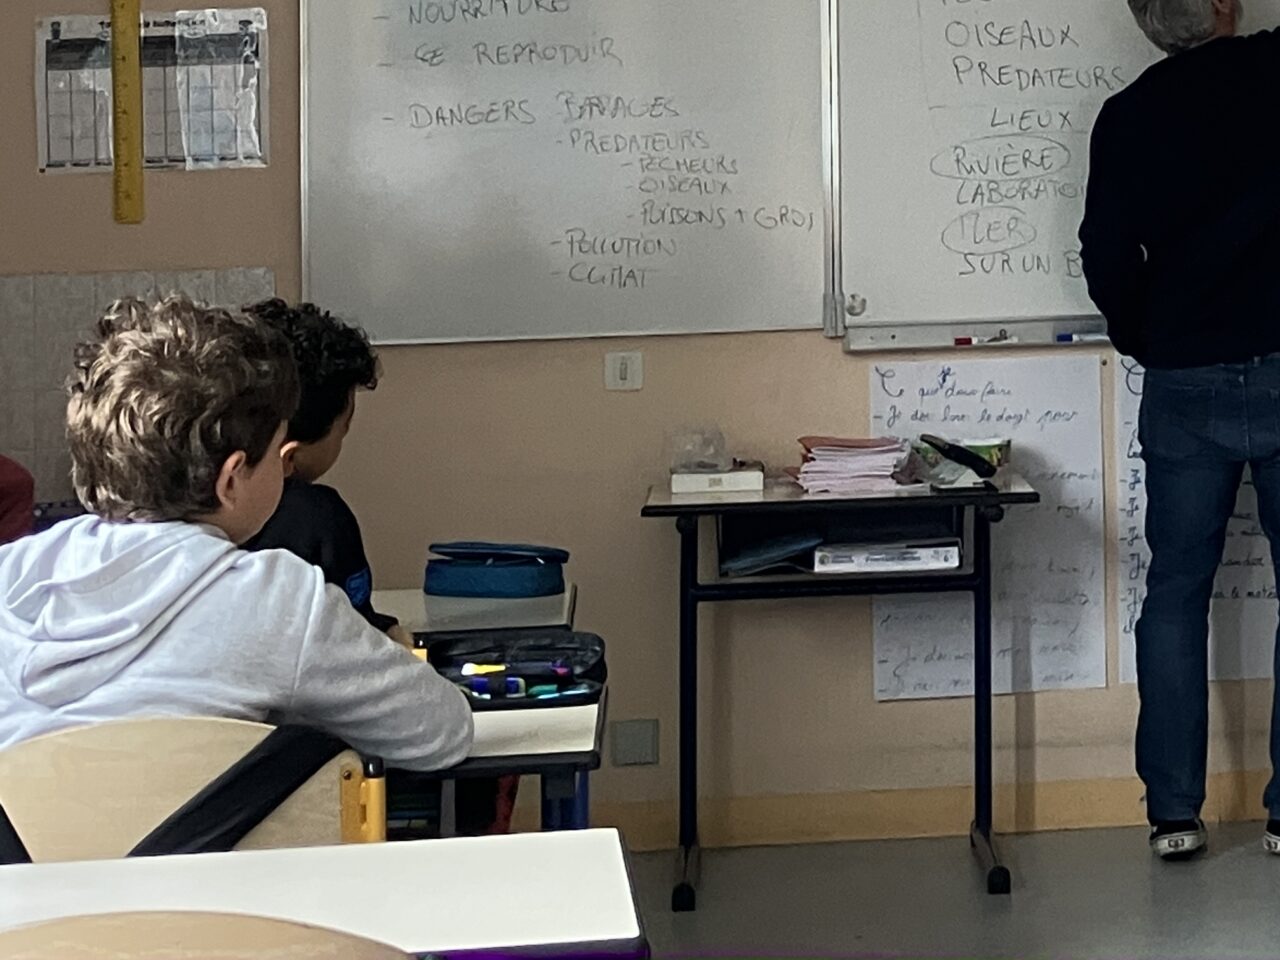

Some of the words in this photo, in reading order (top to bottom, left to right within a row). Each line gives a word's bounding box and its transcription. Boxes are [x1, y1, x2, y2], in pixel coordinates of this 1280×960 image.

[944, 18, 1080, 51] OISEAUX
[951, 54, 1131, 92] PREDATEURS
[408, 98, 538, 129] DANGERS
[989, 106, 1073, 132] LIEUX
[568, 127, 711, 155] PREDATEURS
[637, 175, 735, 196] OISEAUX
[956, 178, 1086, 207] LABORATOI
[958, 251, 1014, 277] SUR
[1022, 254, 1050, 275] UN
[1063, 249, 1084, 279] B
